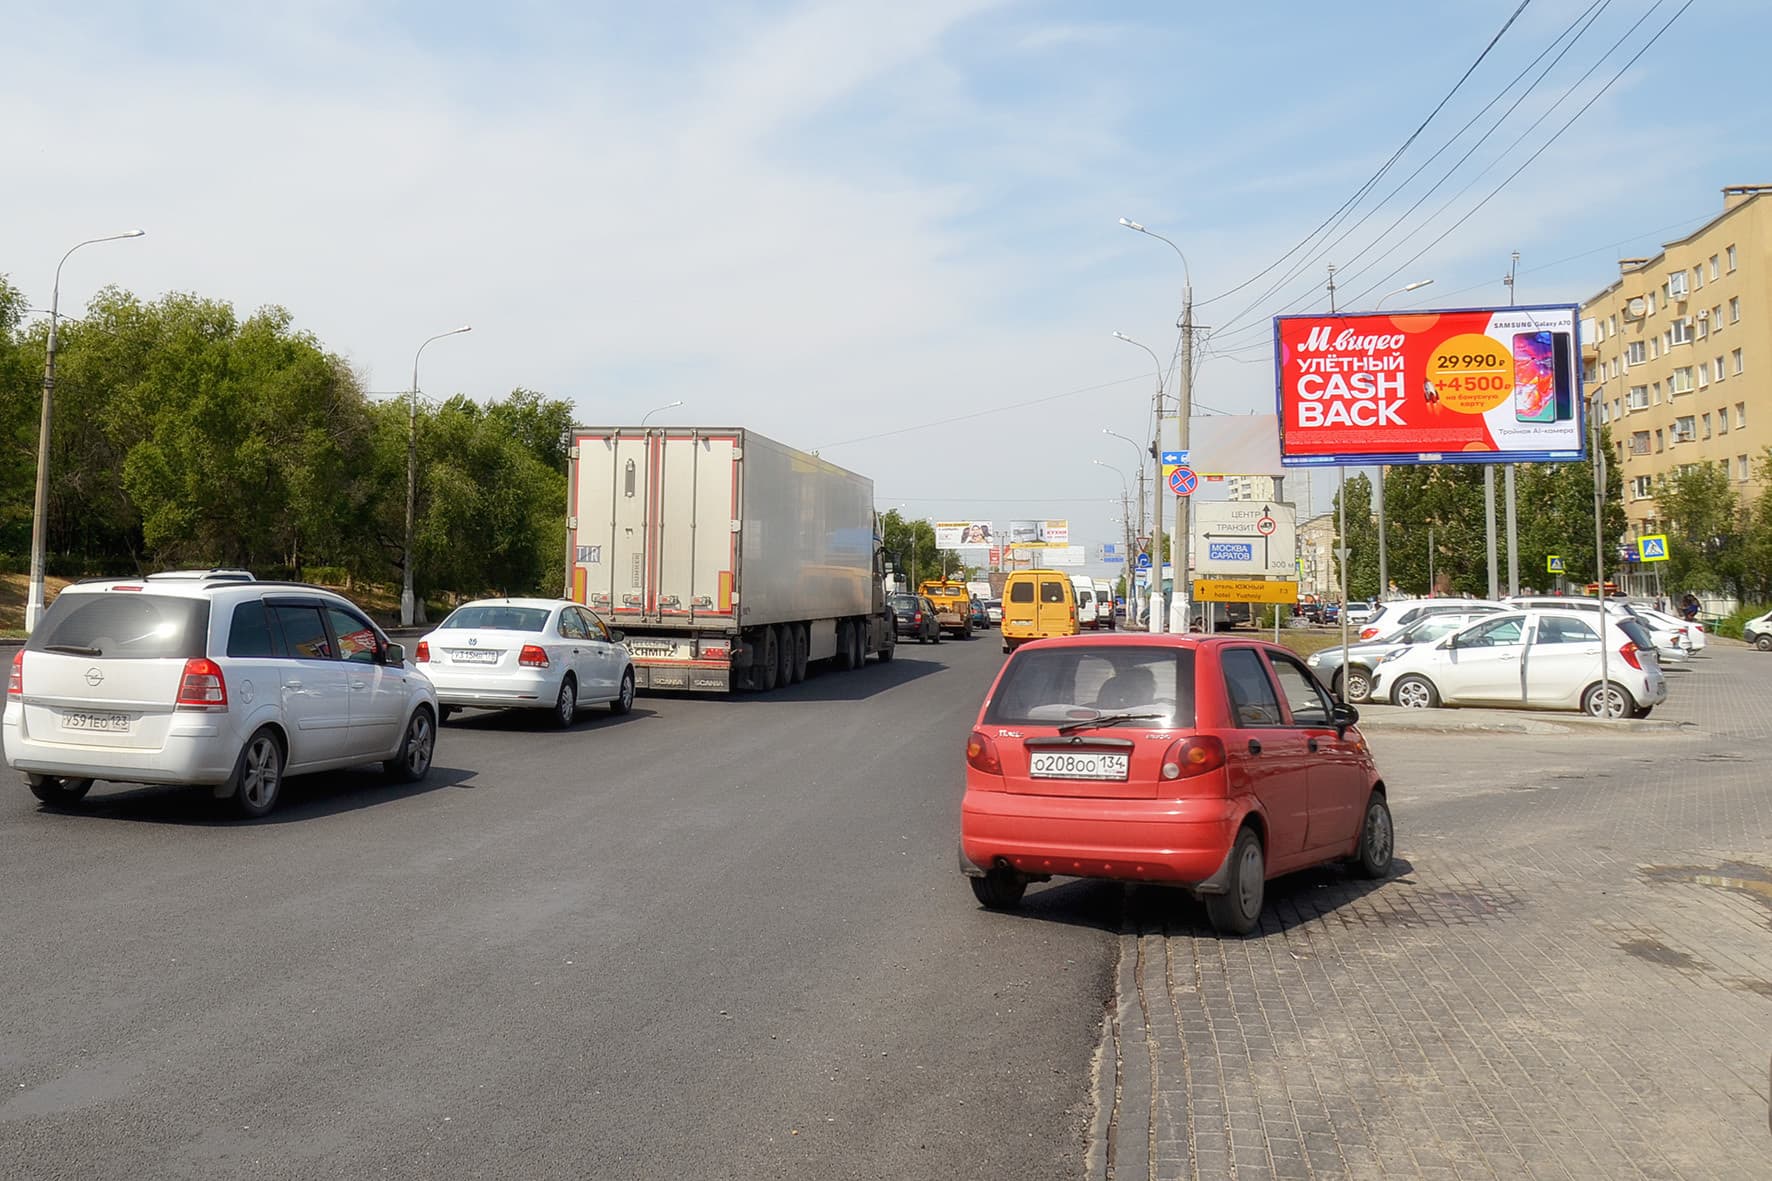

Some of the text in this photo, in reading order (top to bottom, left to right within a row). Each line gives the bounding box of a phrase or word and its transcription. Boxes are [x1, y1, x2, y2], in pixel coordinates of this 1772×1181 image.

[1494, 321, 1532, 329] SAMSUNG
[1296, 351, 1405, 373] УЛЁТНЫЙ
[1297, 372, 1405, 400] CASH
[1298, 399, 1408, 427] BACK
[1231, 511, 1261, 519] ЦЕНТР
[1217, 524, 1256, 532] ТРАНЗИТ
[1211, 544, 1248, 553] МОСКВА
[576, 546, 599, 562] TIR
[1211, 552, 1250, 560] САРАТОВ
[1271, 561, 1287, 569] 300
[629, 647, 675, 657] SCHMITZ
[693, 679, 724, 687] SCANIA
